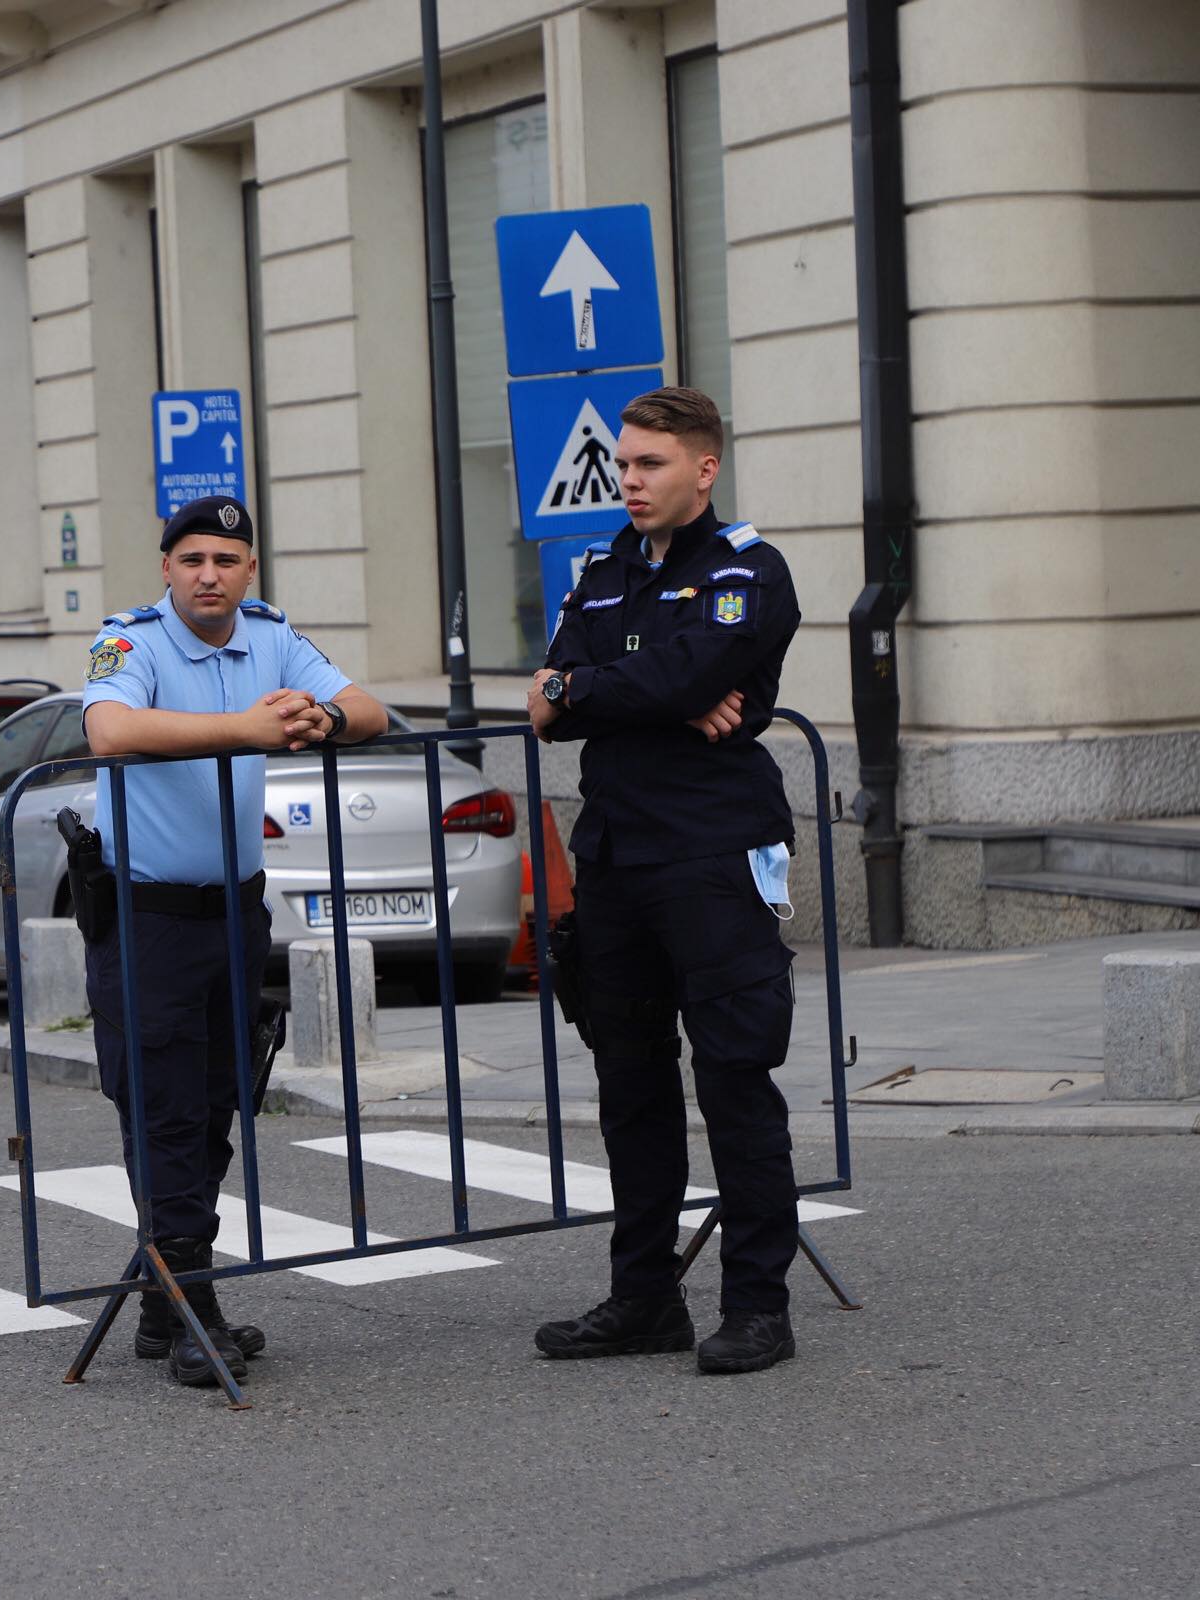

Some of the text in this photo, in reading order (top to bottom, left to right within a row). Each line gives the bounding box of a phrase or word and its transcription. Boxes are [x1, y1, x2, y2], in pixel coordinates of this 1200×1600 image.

[204, 396, 234, 408] HOTEL
[201, 410, 238, 422] CAPITOL
[158, 399, 199, 464] P
[711, 567, 755, 580] JANDARMERIA
[347, 896, 377, 916] 160
[383, 895, 425, 915] NOM
